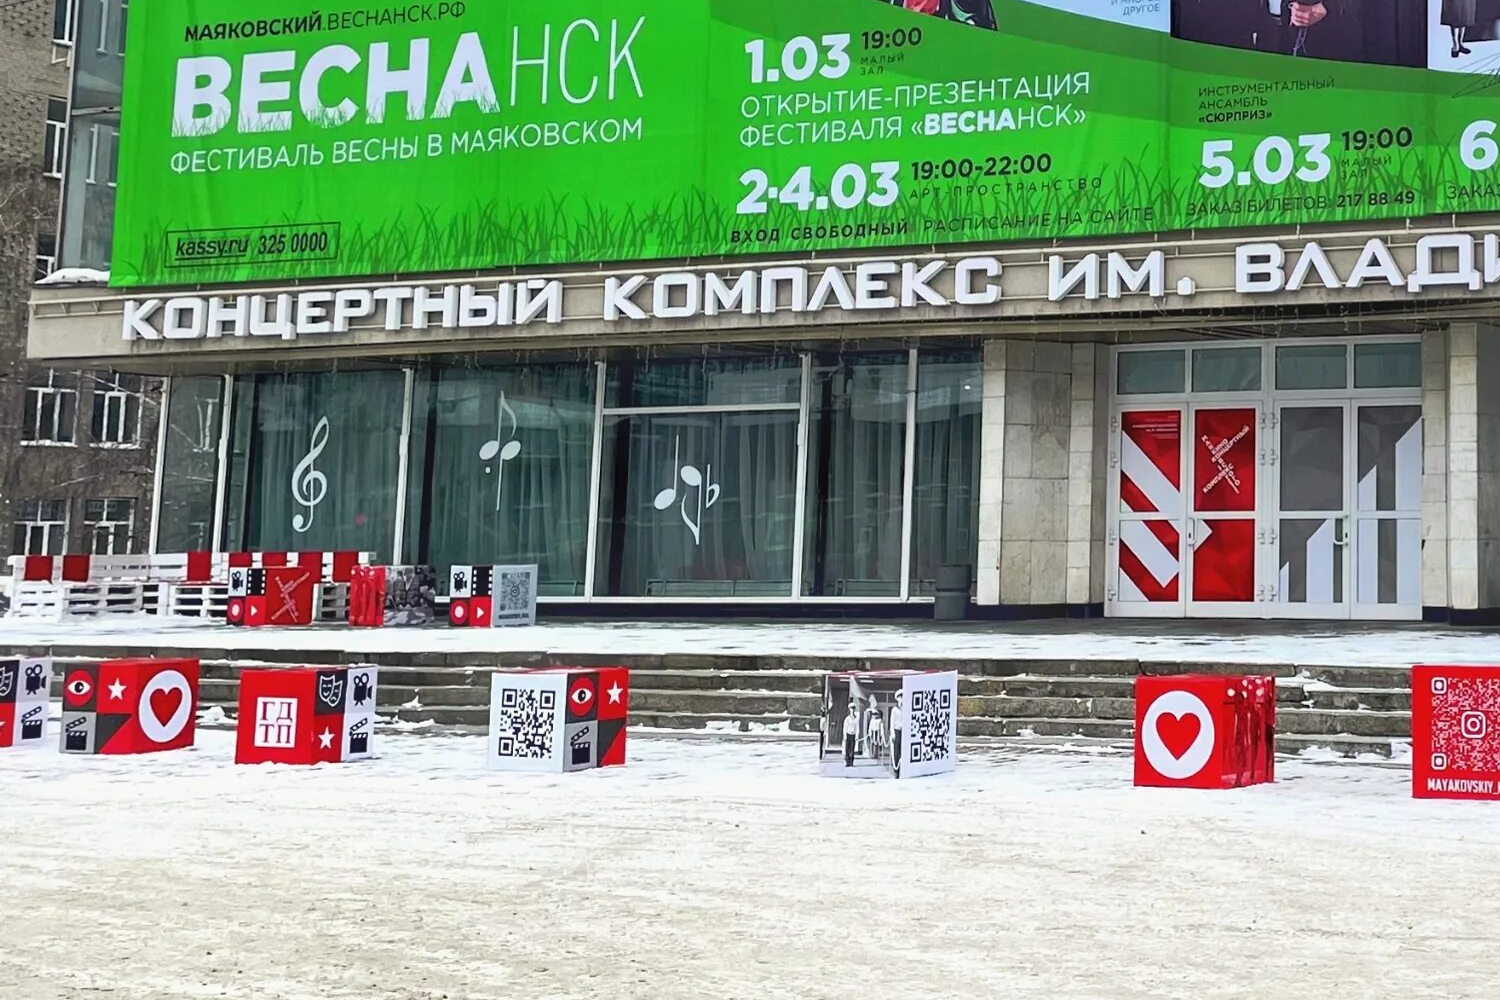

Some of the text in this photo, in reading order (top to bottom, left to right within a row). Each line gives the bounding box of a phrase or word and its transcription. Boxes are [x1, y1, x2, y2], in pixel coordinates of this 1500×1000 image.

[184, 1, 466, 41] МАЯКОВСКИЙ.ВЕСНАНСК.РФ
[1123, 3, 1161, 16] ДРУГОЕ
[861, 27, 922, 50] 19:00
[744, 32, 851, 83] 1.03
[860, 52, 905, 65] МАЛЫЙ
[740, 71, 1090, 118] ОТКРЫТИЕ-ПРЕЗЕНТАЦИЯ
[1199, 76, 1335, 97] ИНСТРУМЕНТАЛЬНЫЙ
[1199, 97, 1268, 110] АНСАМБЛЬ
[1199, 109, 1272, 123] «СЮРПРИЗ»
[739, 102, 1087, 147] ФЕСТИВАЛЯ «ВЕСНАНСК»
[1341, 126, 1414, 151] 19:00
[170, 117, 643, 174] ФЕСТИВАЛЬ ВЕСНЫ В МАЯКОВСКОМ
[911, 152, 1052, 181] 19:00-22:00
[1199, 132, 1332, 189] 5.03
[731, 219, 908, 244] ВХОД СВОБОДНЫЙ
[924, 204, 1154, 233] РАСПИСАНИЕ НА САЙТЕ
[175, 231, 328, 260] kassy.ru 325 0000
[122, 278, 563, 341] КОНЦЕРТНЫЙ
[604, 256, 1003, 321] КОМПЛЕКС
[1048, 249, 1196, 302] ИМ.
